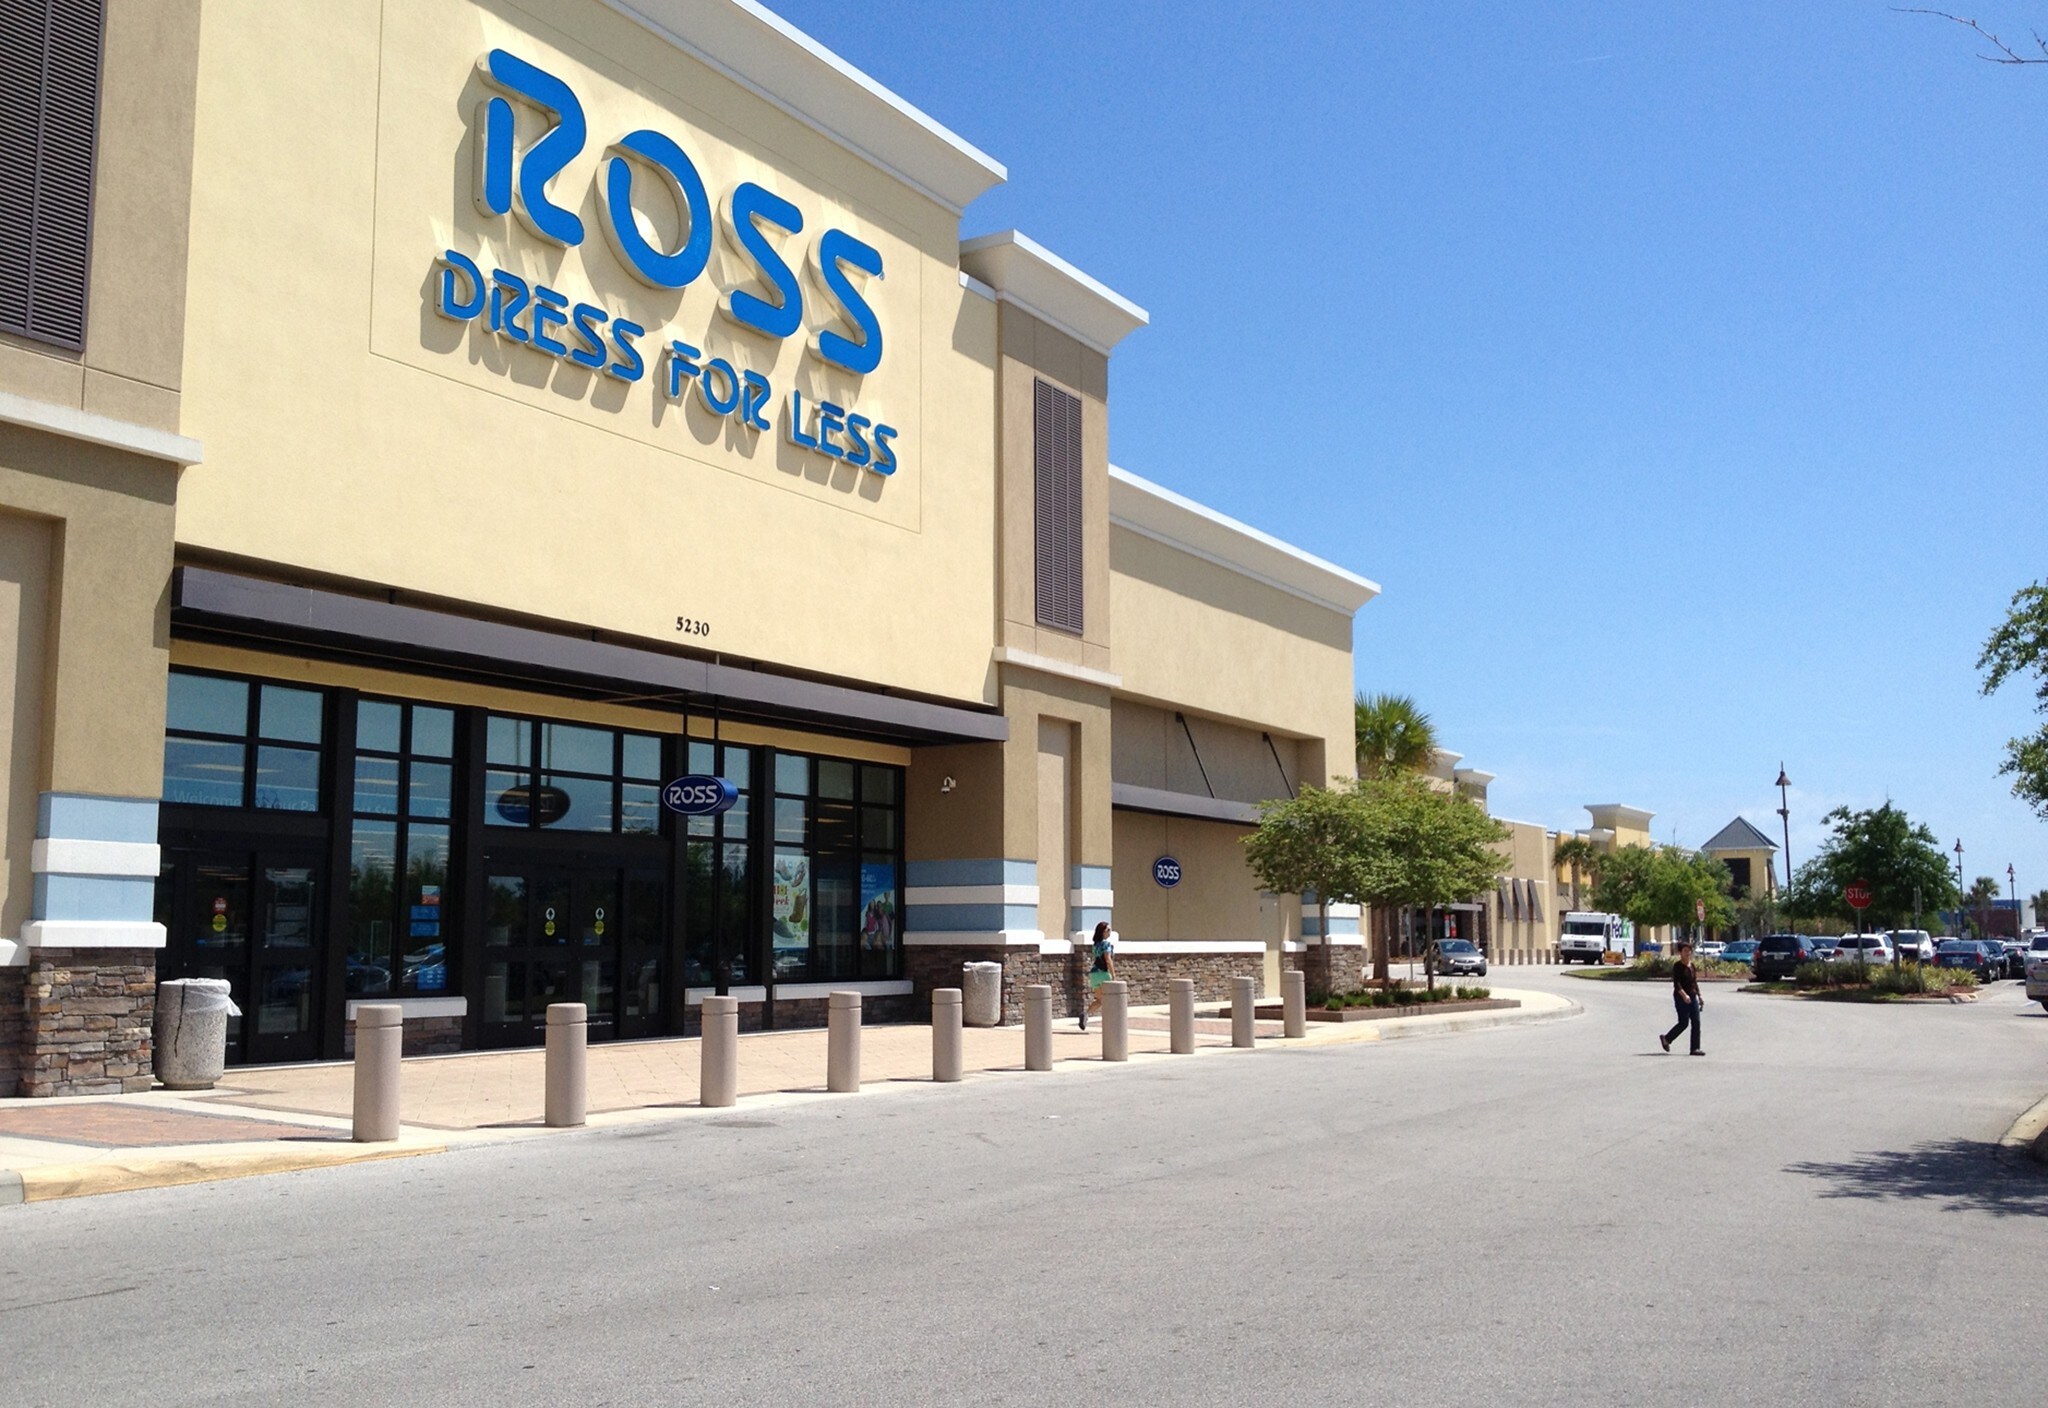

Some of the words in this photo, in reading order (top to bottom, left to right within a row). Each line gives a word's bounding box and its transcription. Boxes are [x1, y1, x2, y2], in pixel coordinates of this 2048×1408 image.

[485, 48, 884, 375] ROSS
[442, 249, 645, 383] DRESS
[670, 339, 772, 432] FOR
[792, 389, 898, 477] LESS
[675, 616, 711, 637] 5230
[669, 784, 718, 805] ROSS
[1157, 864, 1180, 880] ROSS
